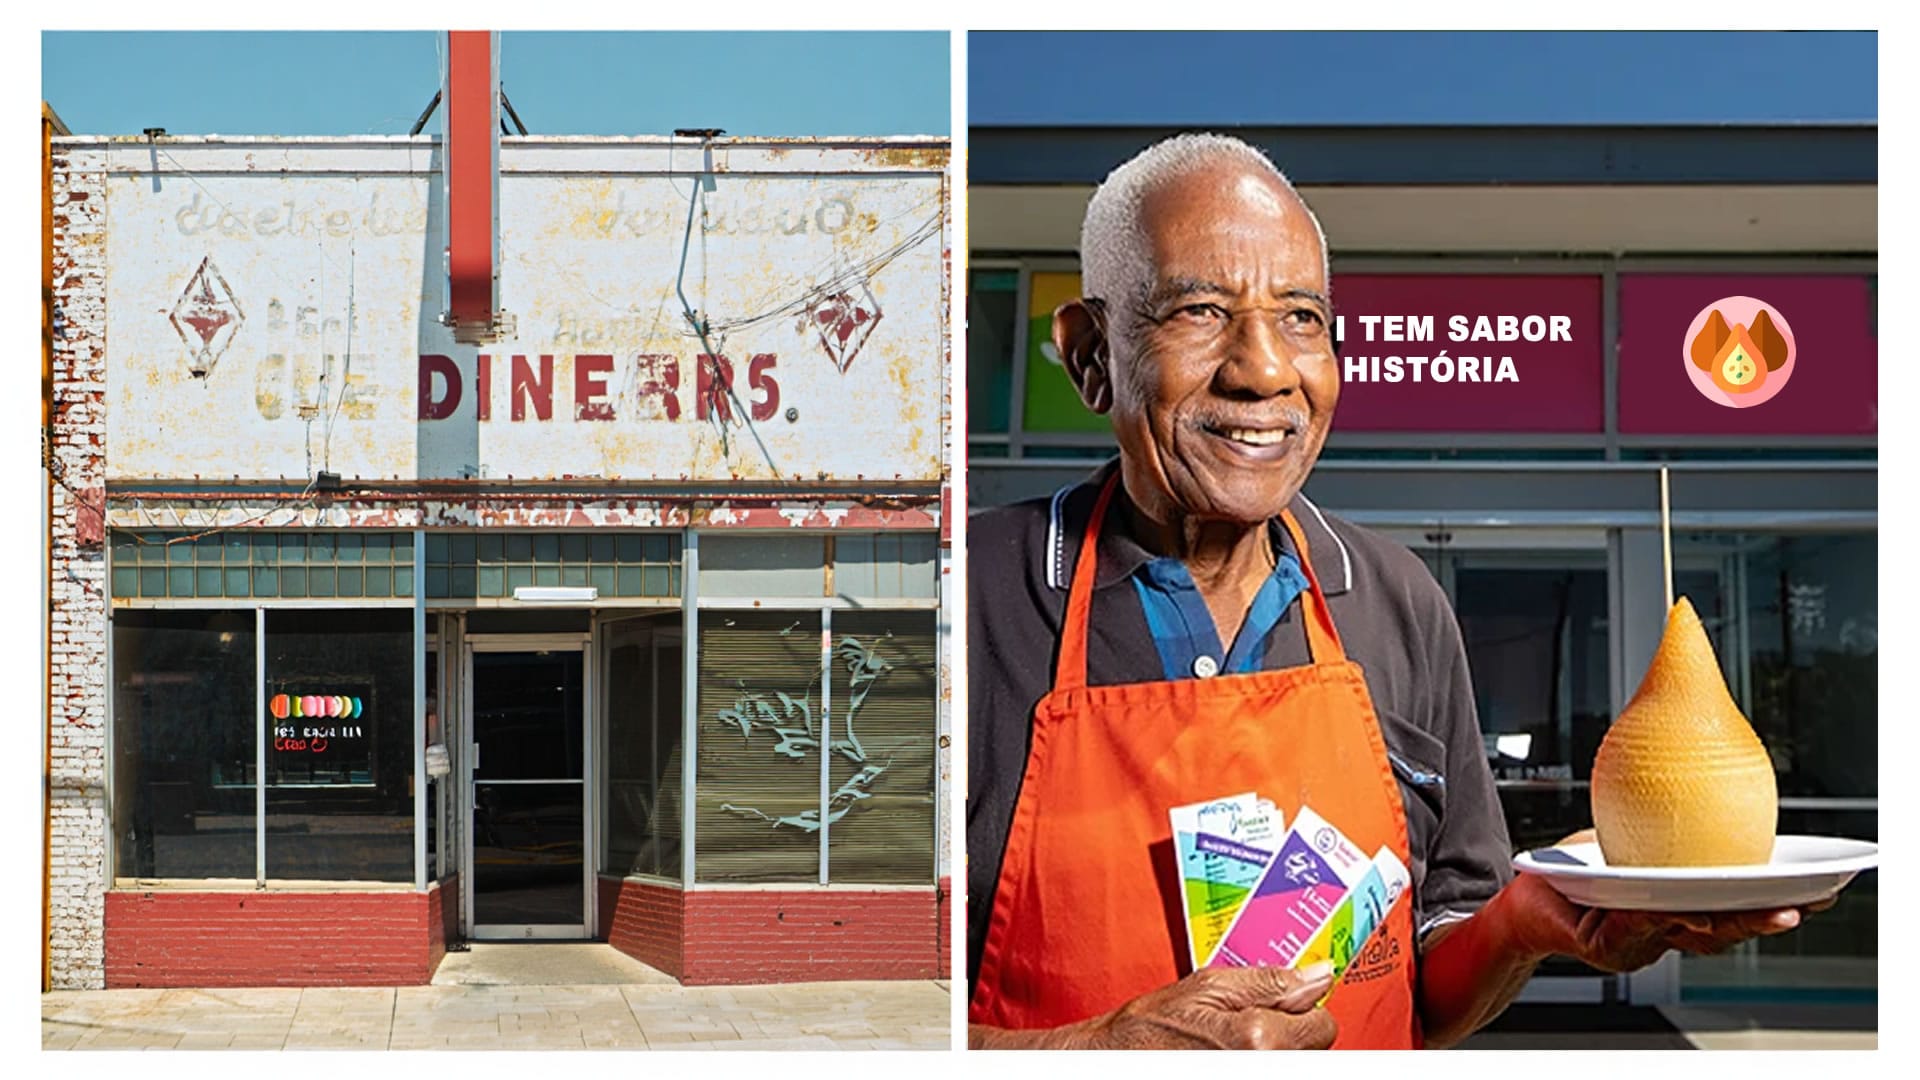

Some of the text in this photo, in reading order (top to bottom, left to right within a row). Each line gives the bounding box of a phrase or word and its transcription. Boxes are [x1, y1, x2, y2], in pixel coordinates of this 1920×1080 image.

[1359, 315, 1434, 341] TEM
[1448, 315, 1573, 342] SABOR
[1344, 350, 1520, 382] HISTÓRIA
